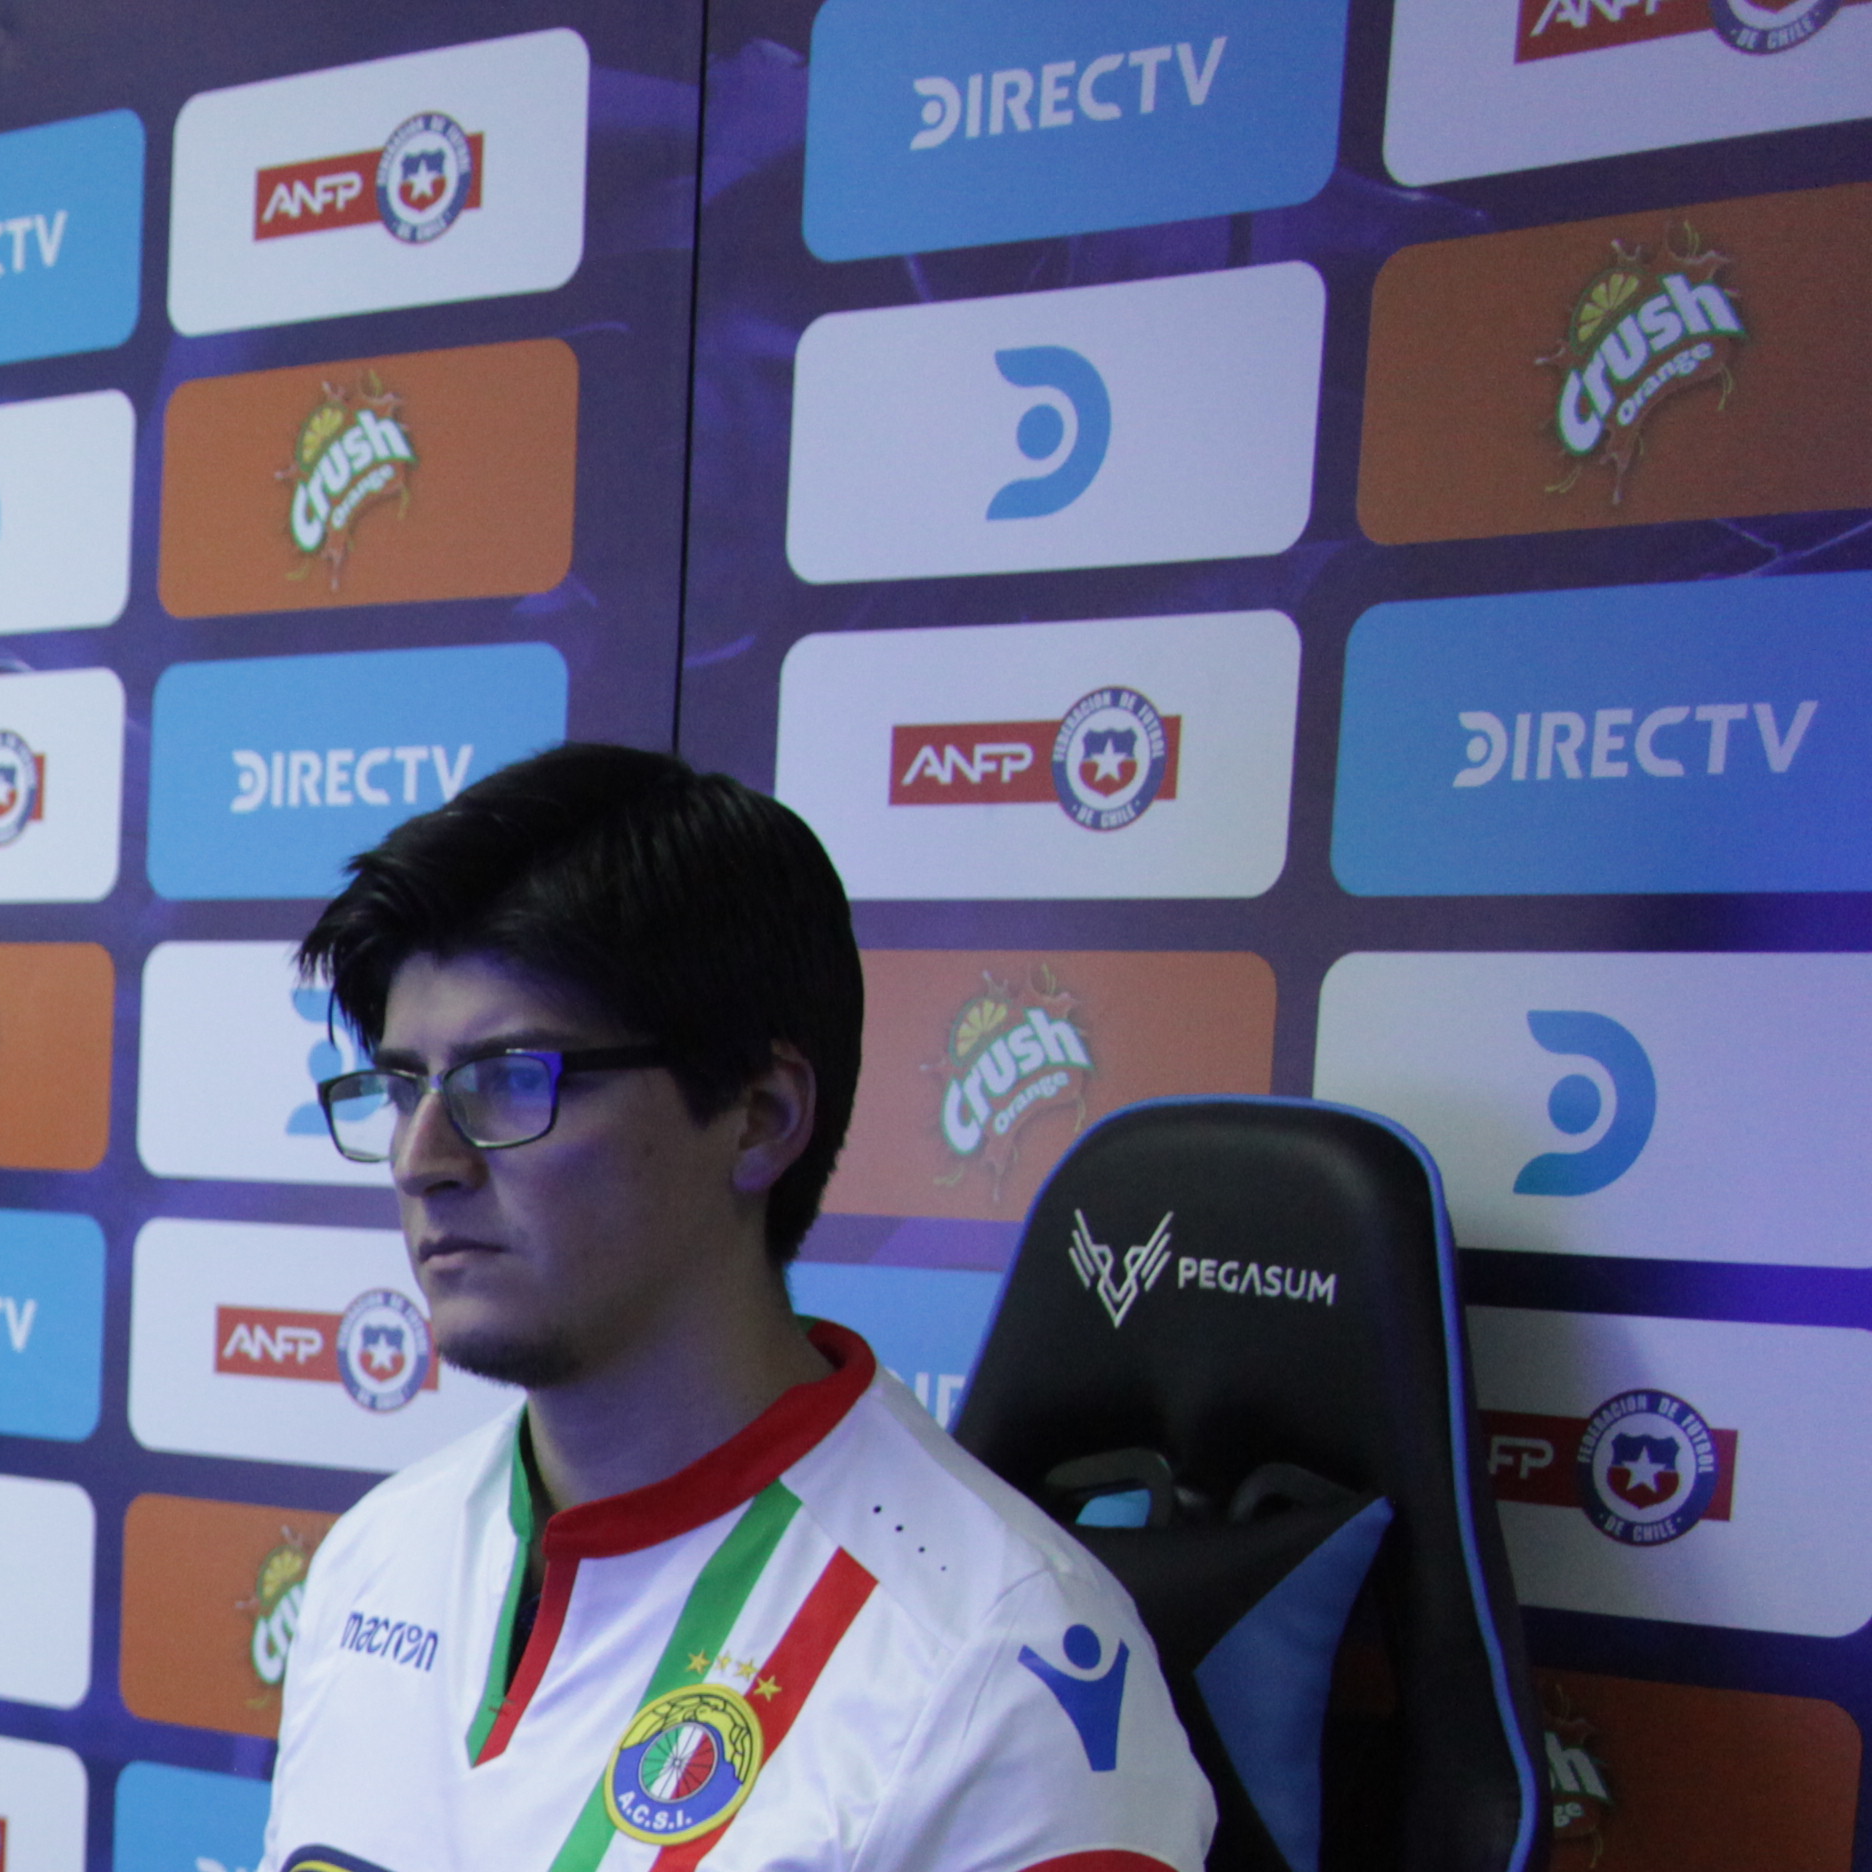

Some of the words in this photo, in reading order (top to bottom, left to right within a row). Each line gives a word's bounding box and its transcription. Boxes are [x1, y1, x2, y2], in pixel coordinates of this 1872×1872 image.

[908, 36, 1228, 152] DIRECTV
[262, 171, 363, 223] ANFP
[901, 743, 1034, 786] ANFP
[1452, 698, 1819, 788] DIRECTV
[229, 743, 472, 813] DIRECTV
[1177, 1255, 1337, 1307] PEGASUM
[223, 1323, 324, 1364] ANFP
[1488, 1435, 1553, 1479] FP
[1578, 1394, 1647, 1463] FEDERACION
[1658, 1397, 1679, 1418] DE
[1681, 1415, 1714, 1474] FUTBOL
[1605, 1517, 1623, 1535] DE
[1633, 1520, 1676, 1542] CHILE
[341, 1611, 439, 1672] macron
